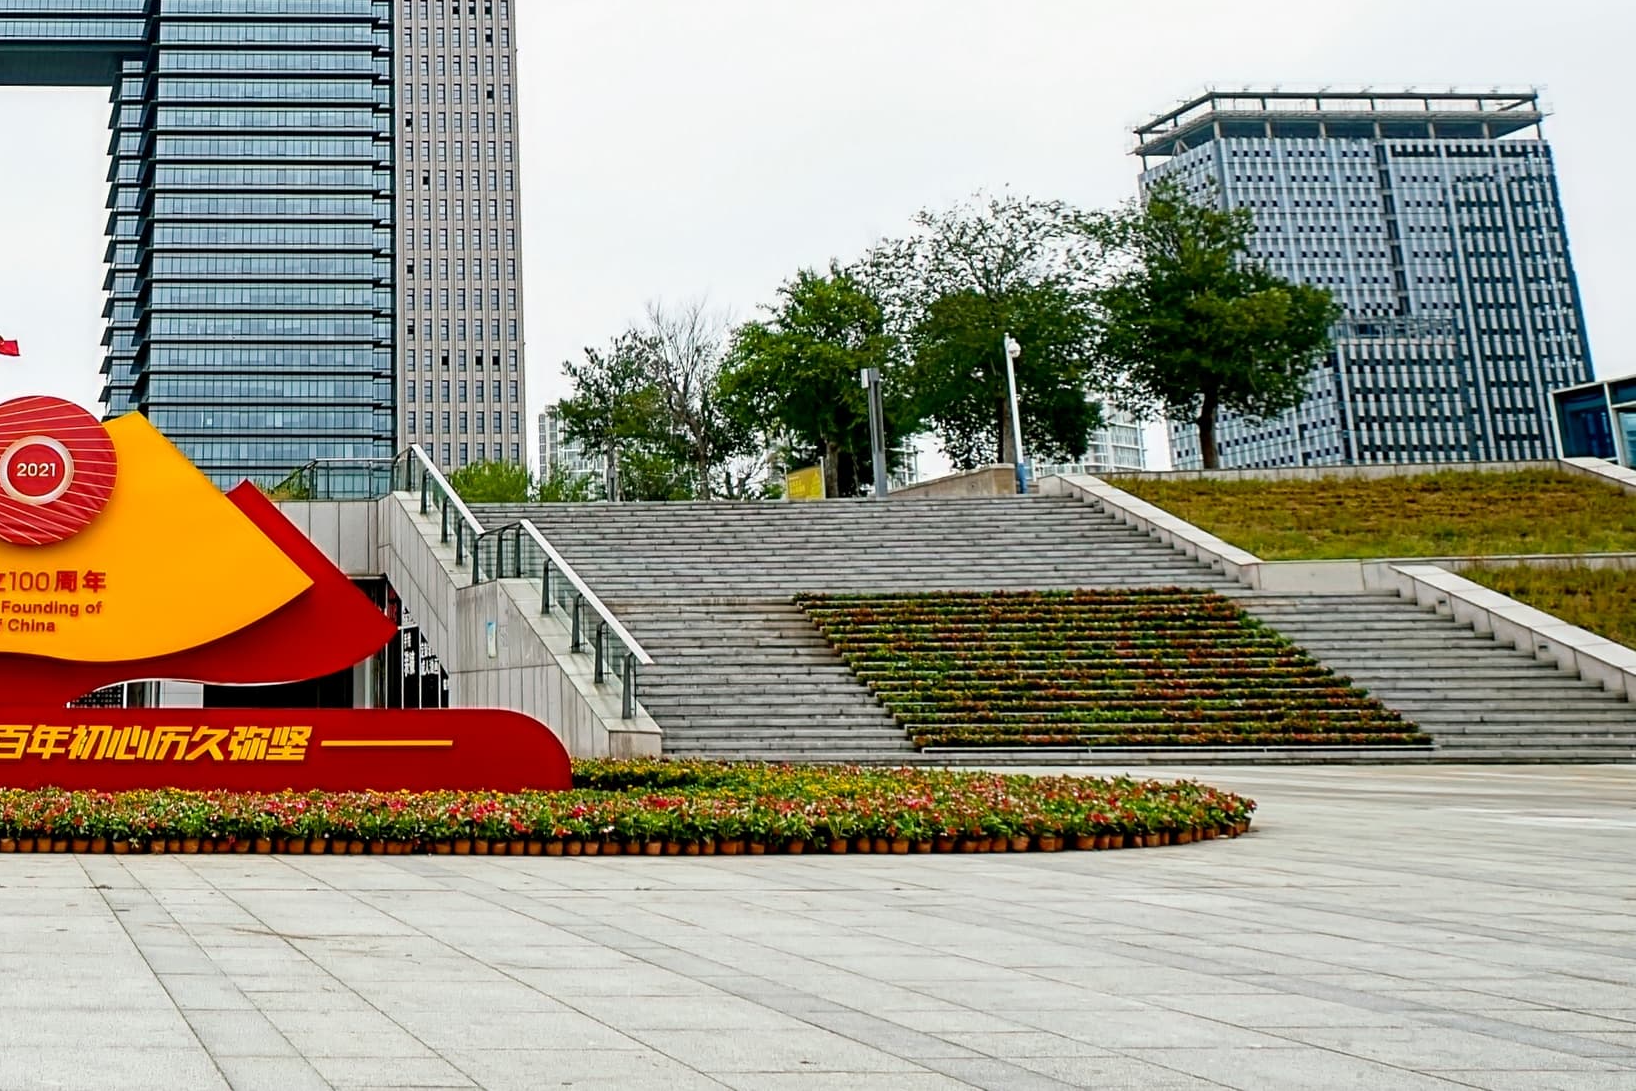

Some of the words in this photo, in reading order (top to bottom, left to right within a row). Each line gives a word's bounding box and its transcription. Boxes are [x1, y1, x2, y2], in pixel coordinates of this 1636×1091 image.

[16, 462, 56, 477] 2021
[1, 600, 80, 616] Founding
[85, 600, 102, 614] of
[7, 618, 56, 633] China
